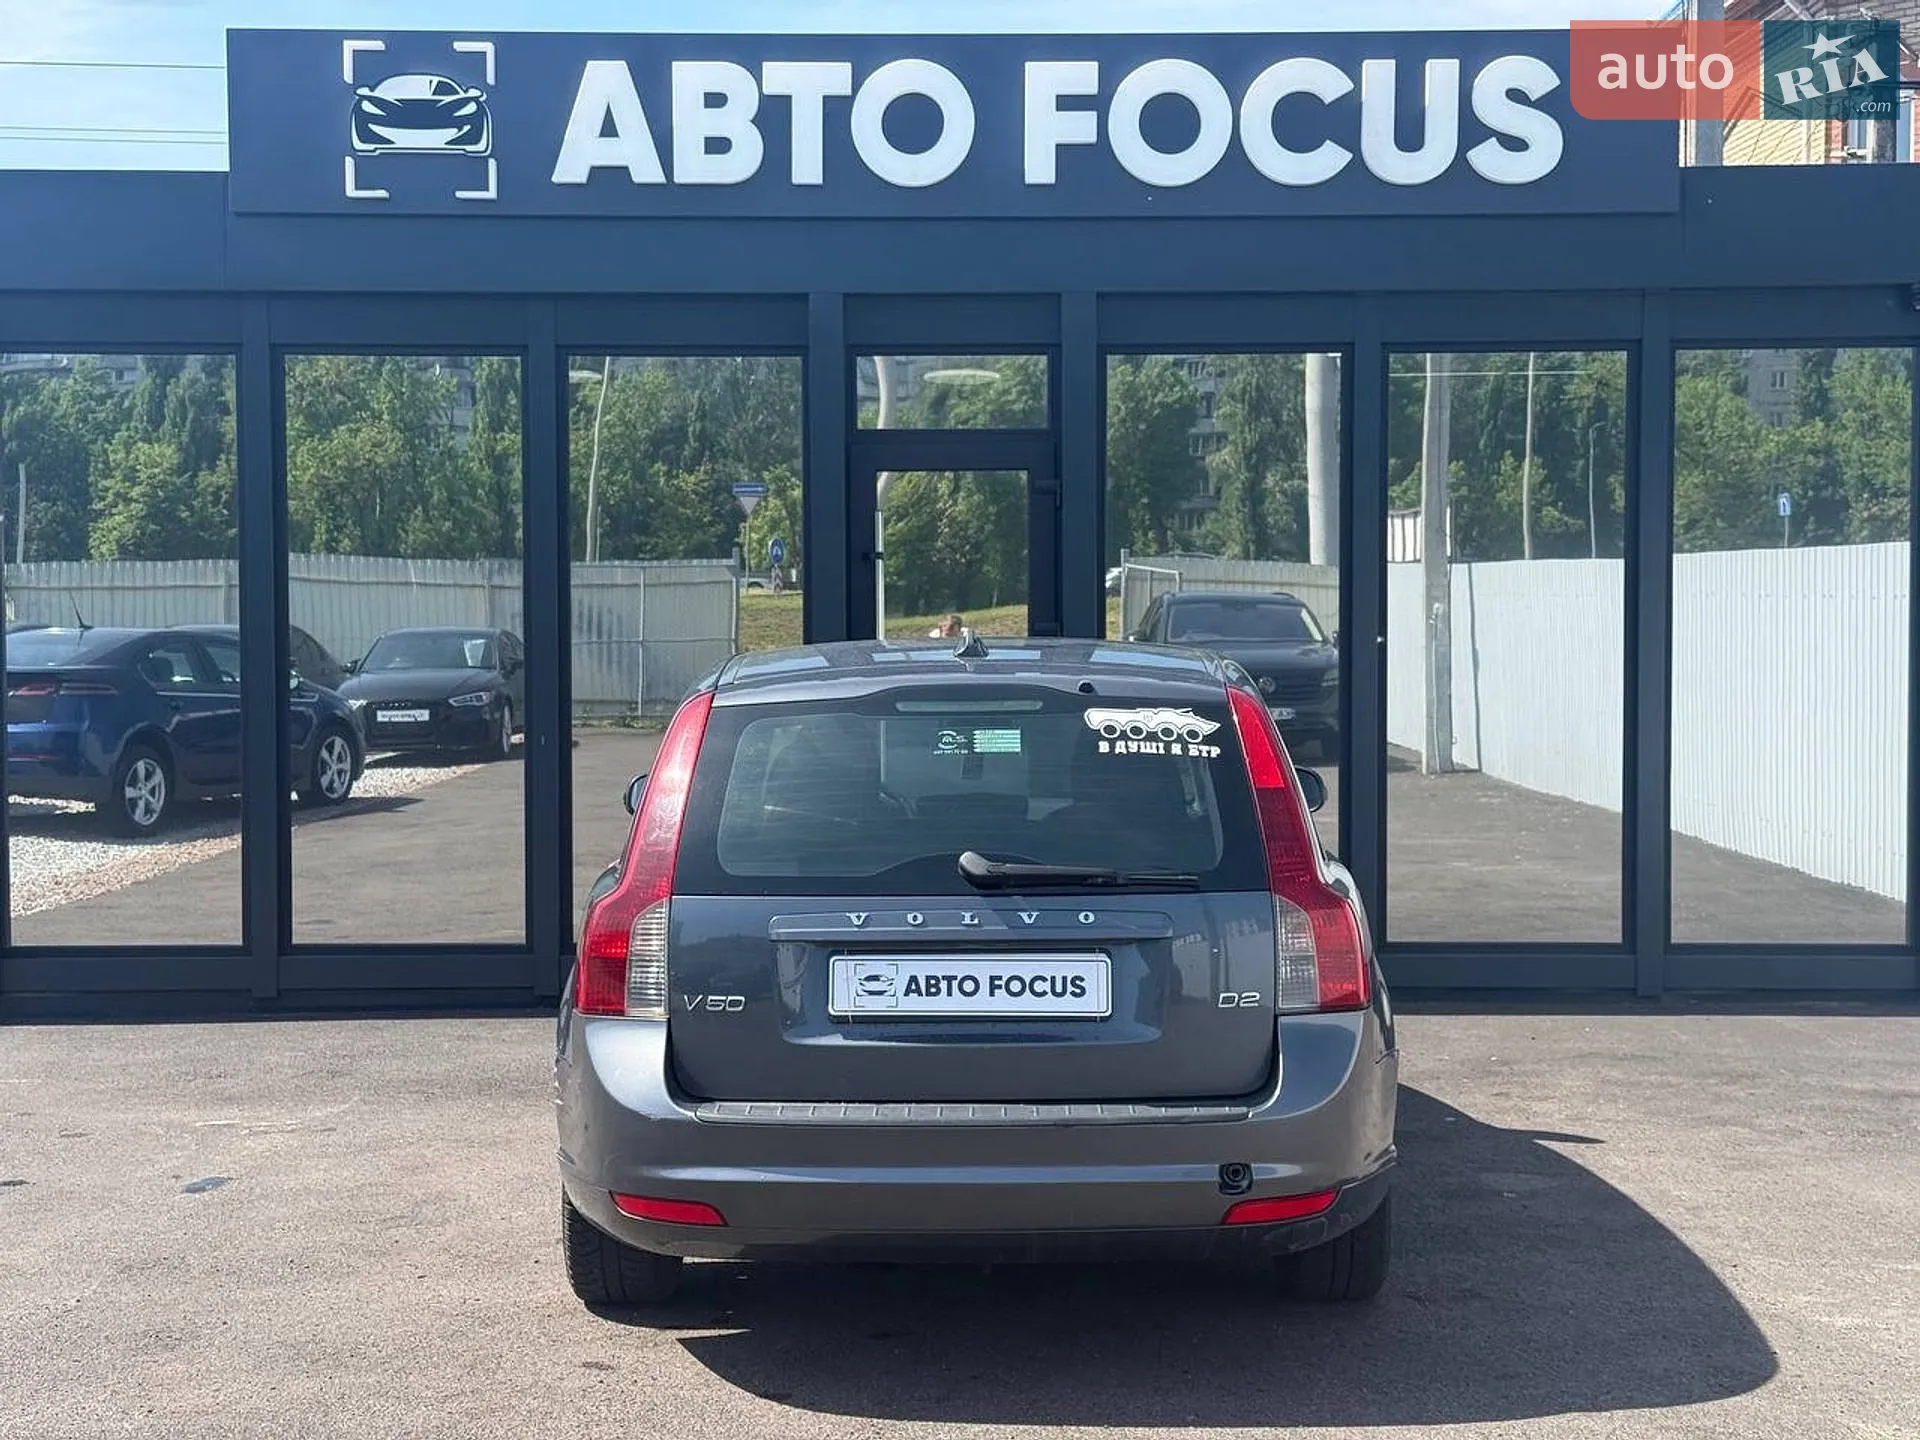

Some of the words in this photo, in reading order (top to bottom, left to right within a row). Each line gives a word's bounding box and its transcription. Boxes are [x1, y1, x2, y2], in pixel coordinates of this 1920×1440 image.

[551, 58, 976, 188] АВТО
[1023, 55, 1564, 187] FOCUS
[1098, 741, 1110, 753] В
[1115, 740, 1165, 754] ДУШІ
[846, 911, 1096, 926] VOLVO
[903, 975, 980, 998] АВТО
[988, 975, 1086, 998] FOCUS
[683, 995, 746, 1012] V50
[1218, 992, 1260, 1009] D2
